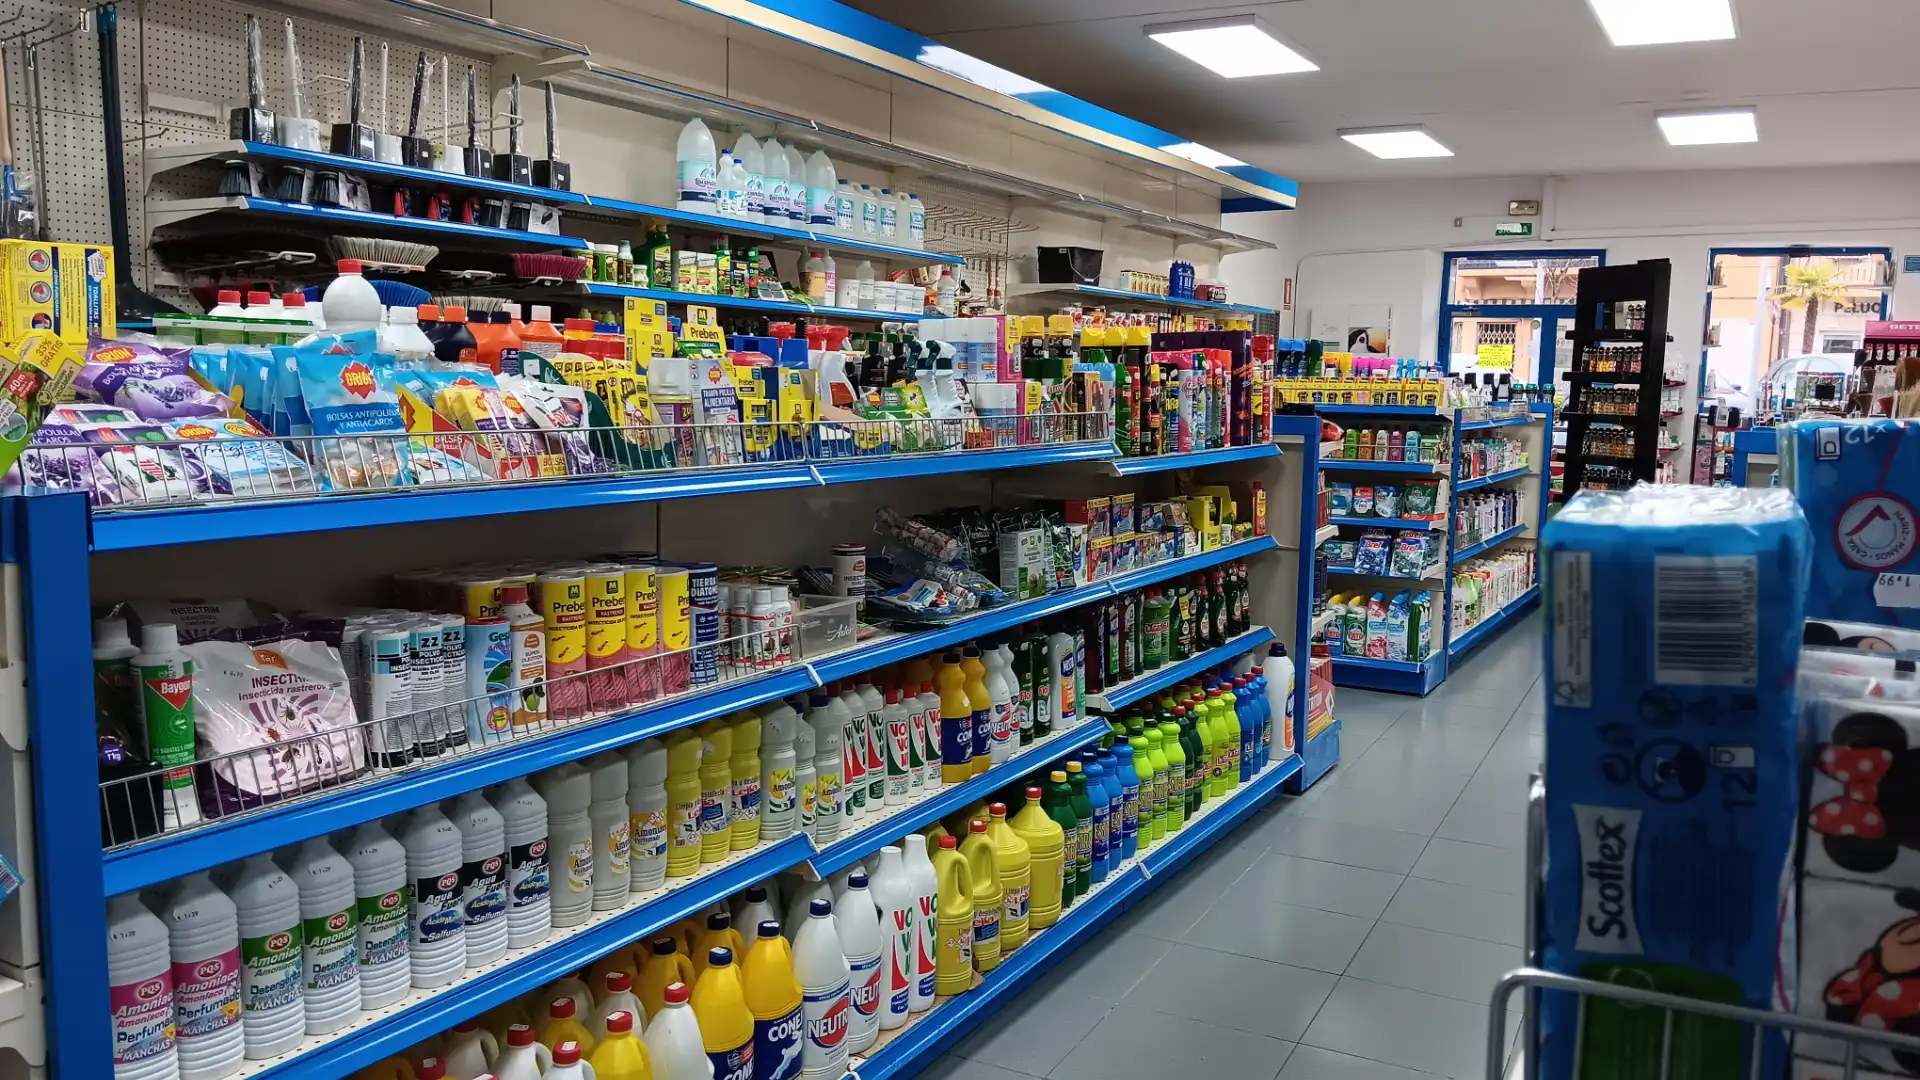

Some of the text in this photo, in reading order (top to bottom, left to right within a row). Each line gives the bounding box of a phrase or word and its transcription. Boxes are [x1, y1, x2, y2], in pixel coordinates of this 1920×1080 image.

[690, 327, 719, 340] Preben
[36, 337, 53, 357] 33%
[40, 341, 63, 368] GRATIS
[97, 347, 132, 362] ORION
[326, 411, 353, 421] BOLSAS
[181, 426, 216, 438] ORION
[1893, 511, 1910, 536] NARIZ
[1365, 540, 1384, 549] Bref
[1401, 543, 1418, 551] Bref
[1847, 538, 1868, 561] CARA
[421, 636, 439, 648] ZZ
[238, 684, 284, 702] Insecticida
[531, 842, 546, 855] PQS
[485, 859, 499, 872] PQS
[518, 858, 542, 872] Agua
[441, 874, 456, 887] PQS
[470, 874, 496, 890] Agua
[1586, 815, 1627, 941] Scottex
[382, 894, 400, 907] PQS
[425, 890, 453, 906] Agua
[331, 915, 347, 929] PQS
[270, 935, 289, 949] PQS
[199, 962, 220, 975] PQS
[140, 983, 161, 998] PQS
[178, 991, 241, 1019] Perfumado
[183, 1018, 229, 1037] MANCHAS
[122, 1040, 171, 1062] MANCHAS
